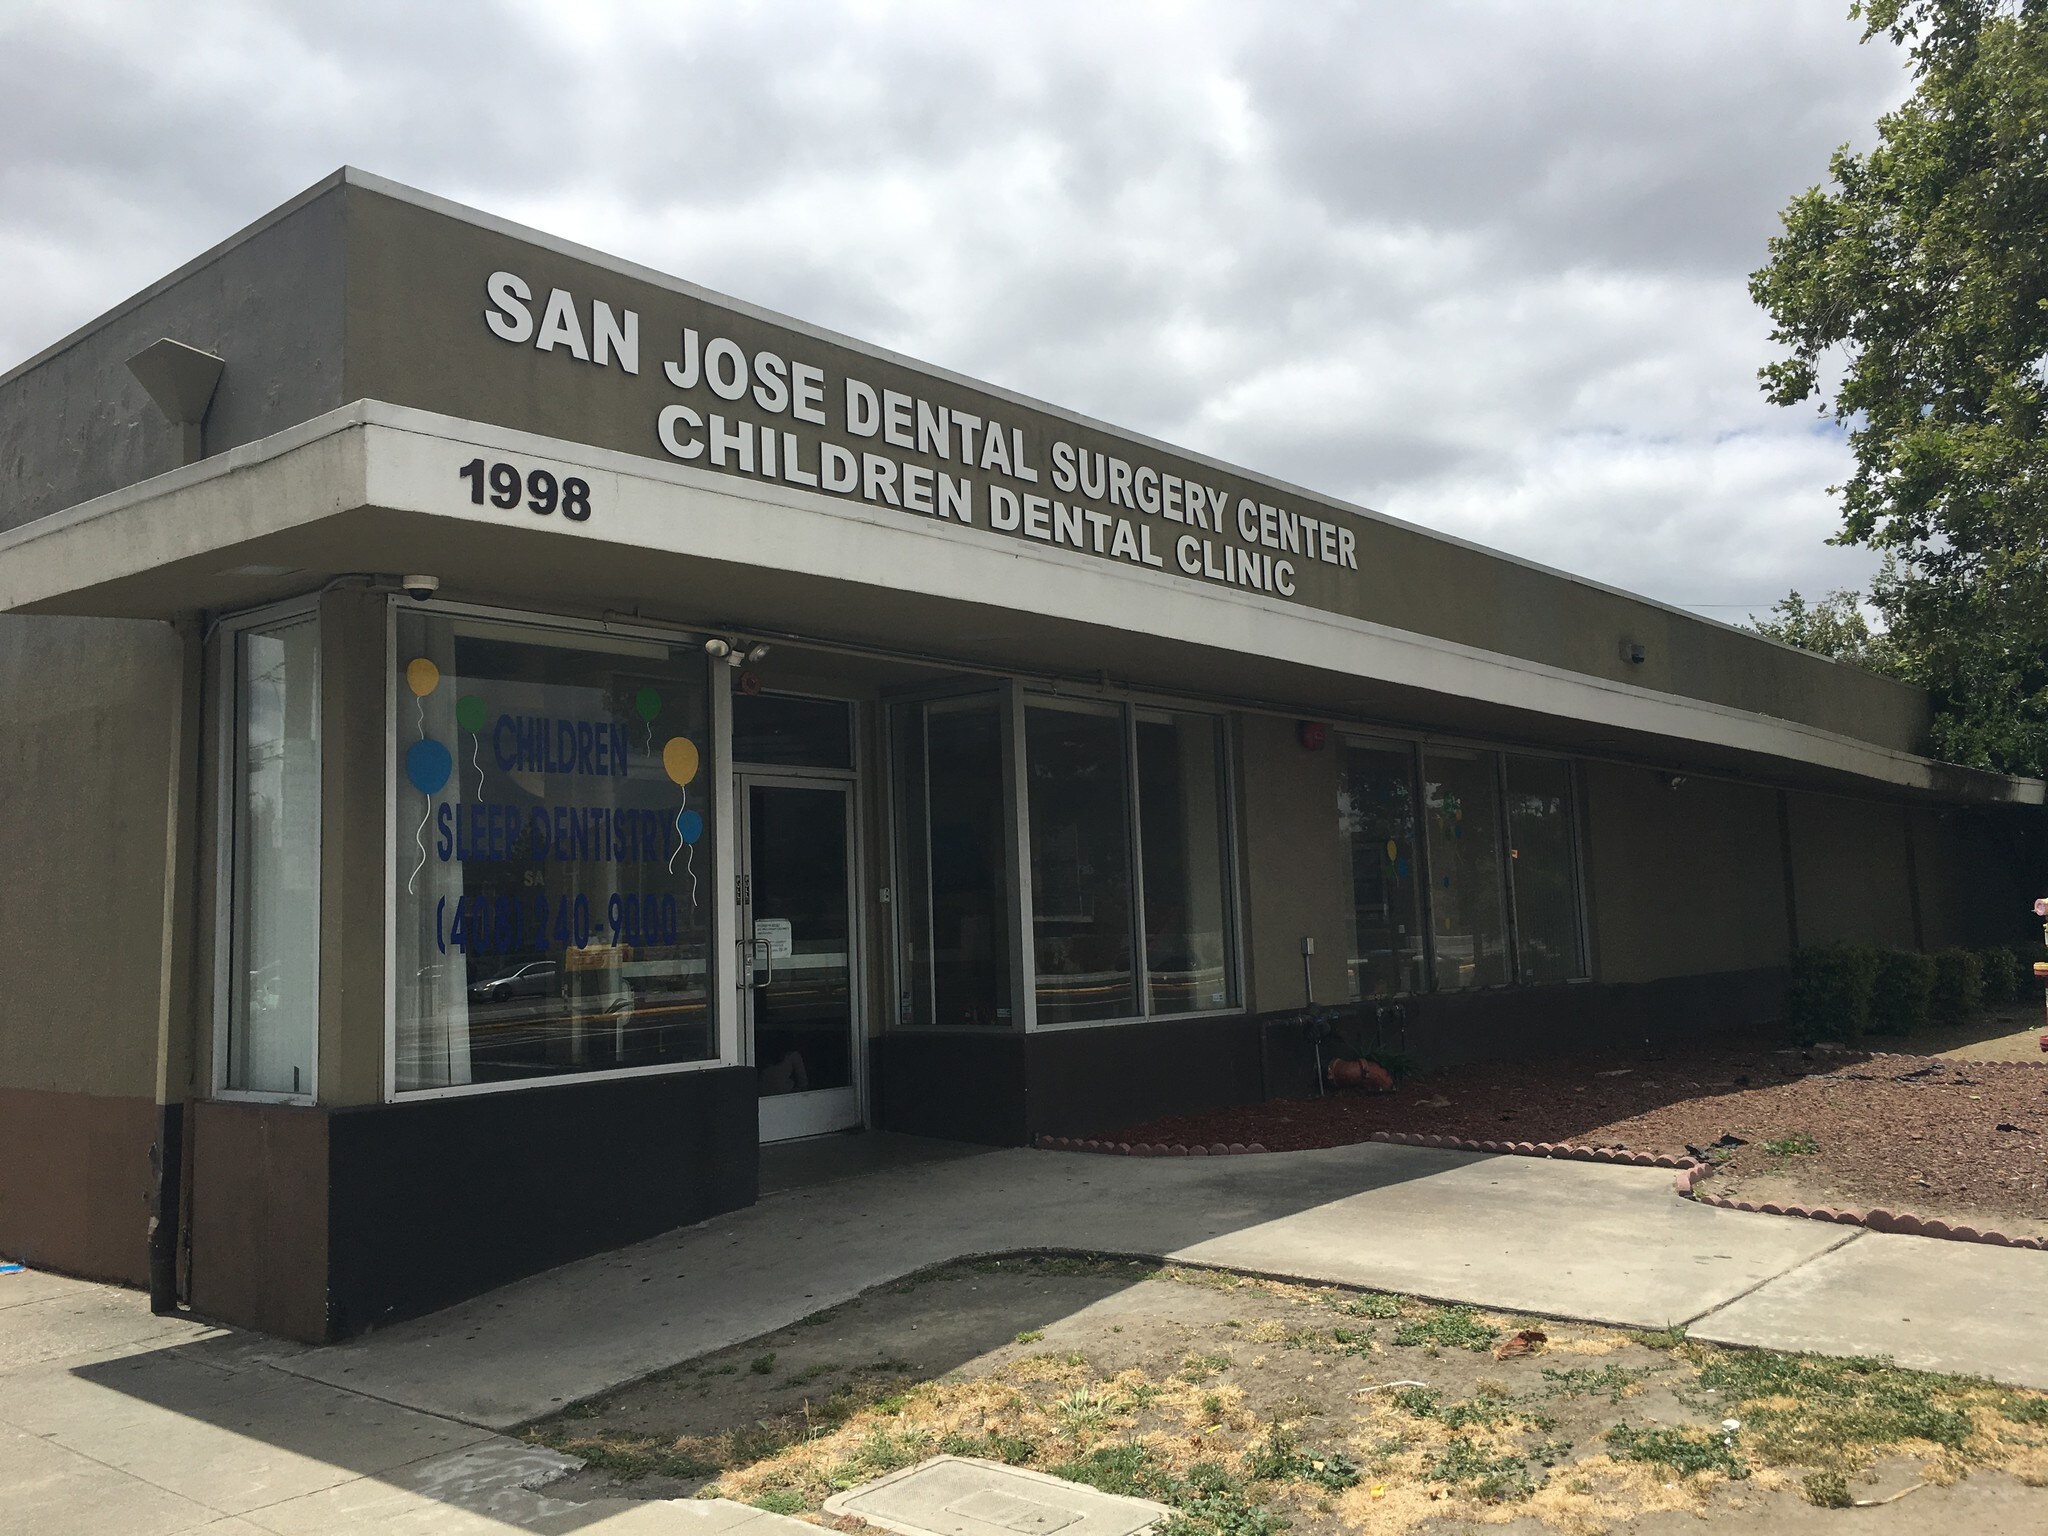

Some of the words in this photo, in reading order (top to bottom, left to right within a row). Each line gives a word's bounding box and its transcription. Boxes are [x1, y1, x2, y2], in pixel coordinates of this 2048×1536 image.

[485, 271, 639, 375] SAN
[663, 327, 827, 426] JOSE
[845, 376, 1039, 484] DENTAL
[1051, 441, 1229, 534] SURGERY
[1237, 497, 1359, 571] CENTER
[459, 457, 592, 522] 1998
[657, 404, 973, 524] CHILDREN
[989, 484, 1164, 568] DENTAL
[1176, 534, 1297, 598] CLINIC
[493, 713, 629, 777] CHILDREN
[437, 802, 522, 863] SLEEP
[531, 806, 676, 863] DENTISTRY
[436, 895, 523, 955] (408)
[533, 892, 676, 952] 240-9000
